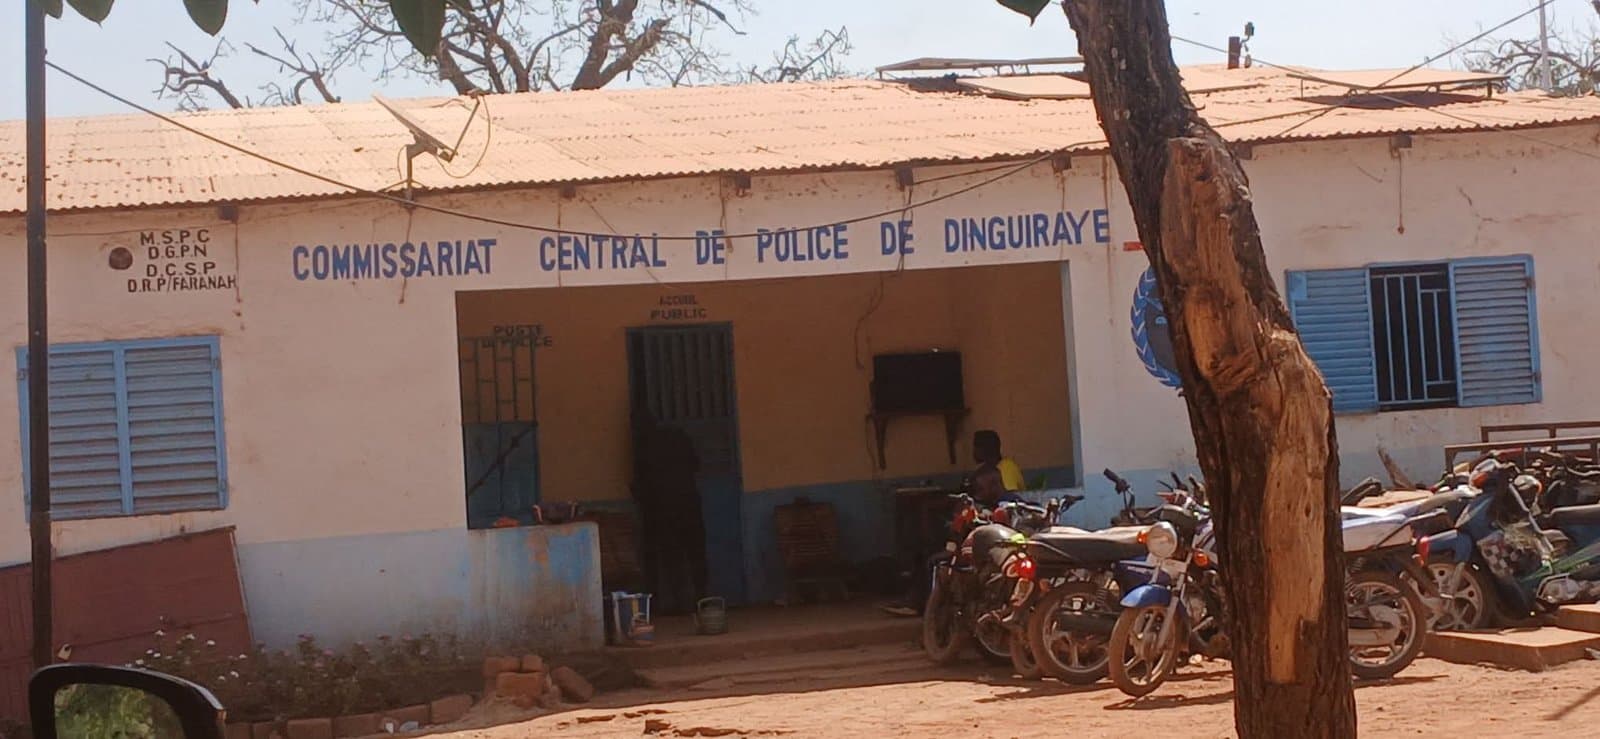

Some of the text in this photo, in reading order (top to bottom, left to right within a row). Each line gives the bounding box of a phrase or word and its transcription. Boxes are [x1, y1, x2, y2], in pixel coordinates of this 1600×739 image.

[293, 209, 1111, 281] COMMISSARIAT CENTRAL DE POLICE DE DINGUIRAYE
[651, 308, 707, 320] PUBLIC
